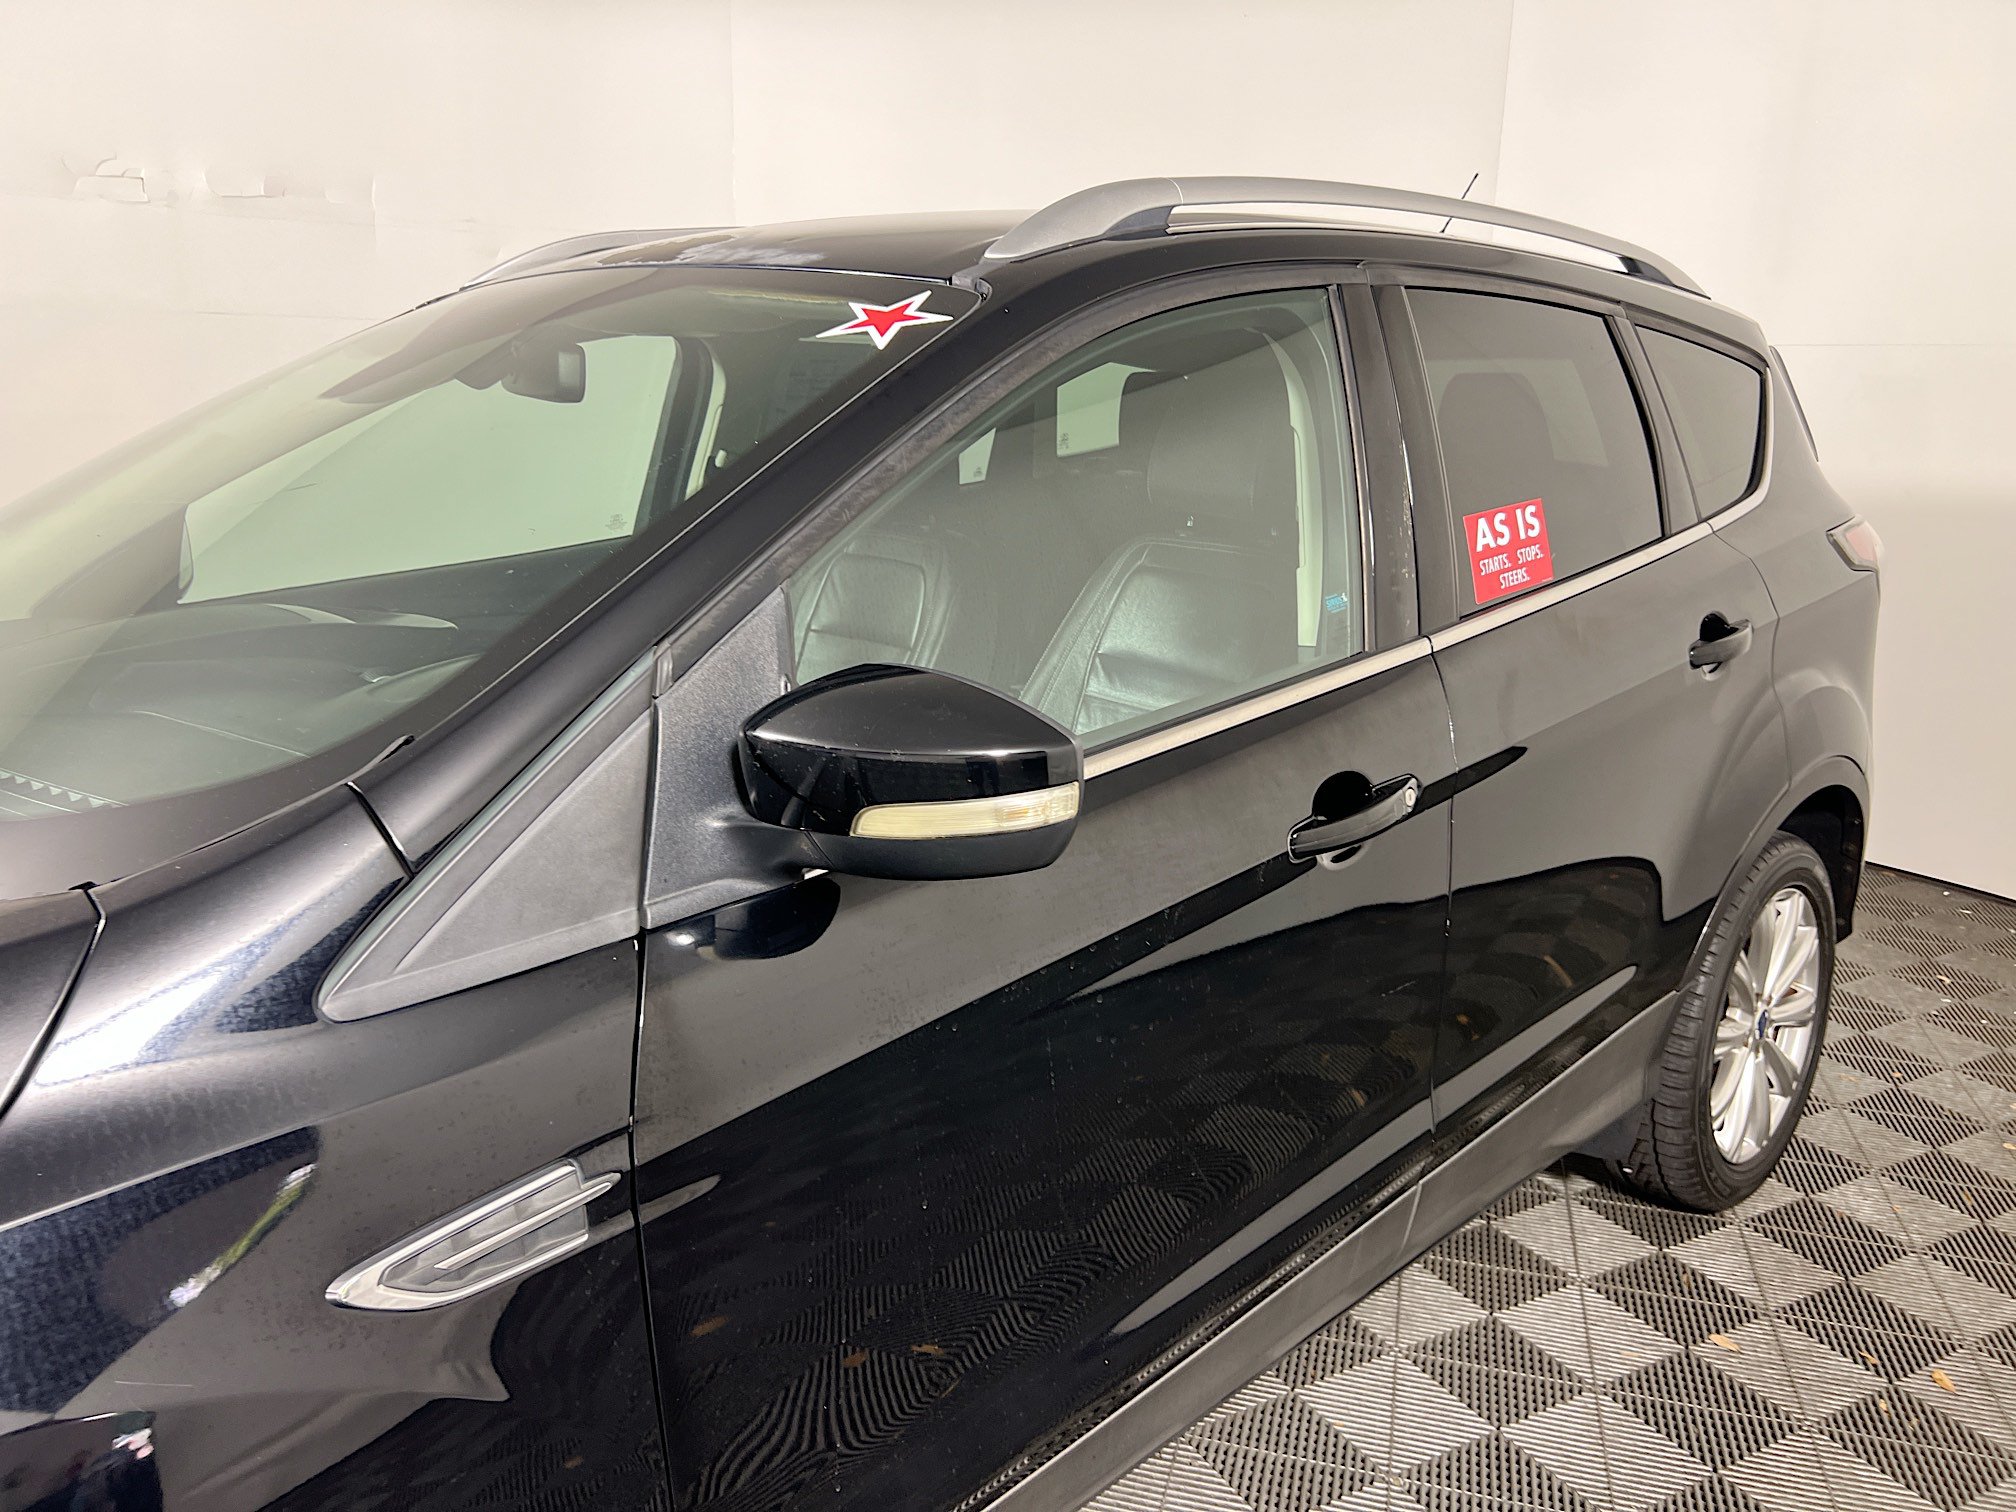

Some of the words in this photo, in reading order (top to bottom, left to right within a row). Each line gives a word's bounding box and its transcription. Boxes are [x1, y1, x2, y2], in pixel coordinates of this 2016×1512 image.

[1476, 512, 1510, 552] AS
[1516, 505, 1540, 540] IS
[1479, 553, 1512, 576] STARTS.
[1517, 544, 1544, 564] STOPS.
[1500, 567, 1530, 589] STEERS.
